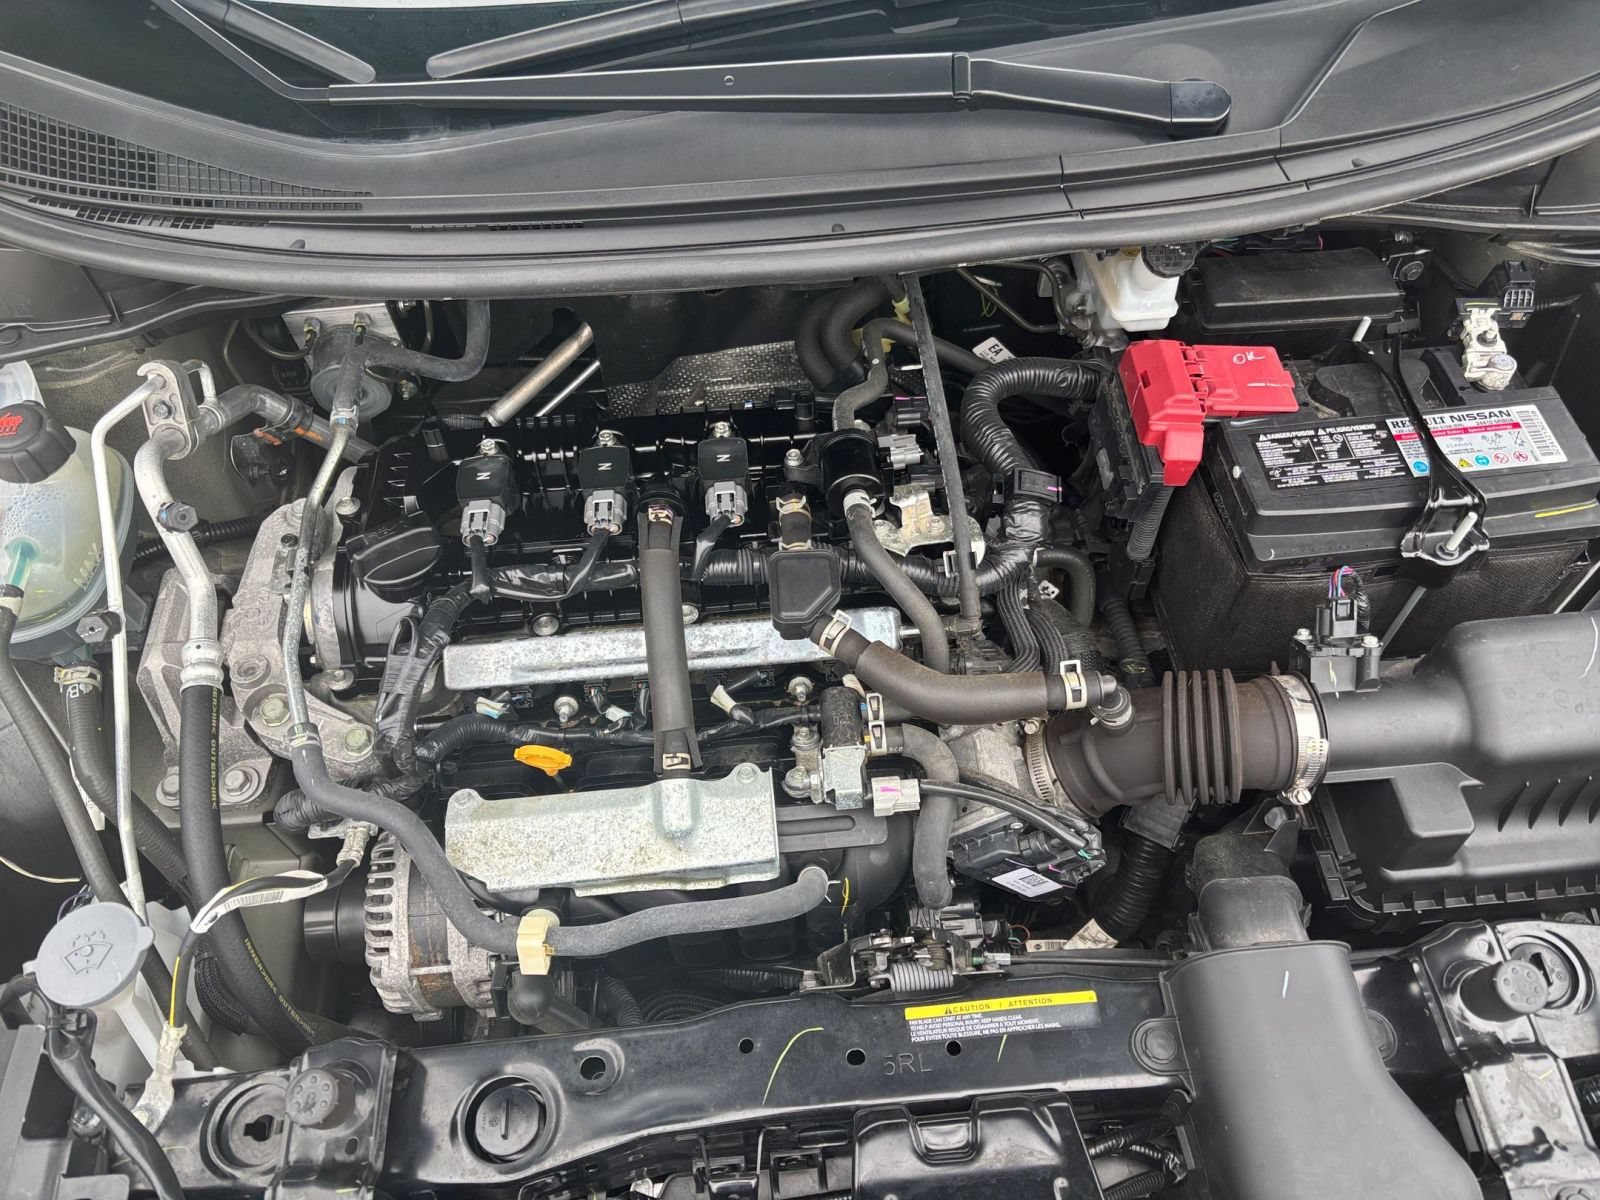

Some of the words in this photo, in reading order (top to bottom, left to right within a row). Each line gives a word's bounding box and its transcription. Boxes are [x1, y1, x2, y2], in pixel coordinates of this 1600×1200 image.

[988, 344, 1003, 356] EA
[1232, 351, 1266, 365] OK
[1390, 416, 1447, 428] REULT
[1448, 409, 1511, 422] NISSAN
[953, 1003, 990, 1012] CAUTION
[1009, 998, 1052, 1007] ATTENTION
[1006, 1024, 1035, 1032] APPROCHER
[882, 1052, 936, 1076] 5RL
